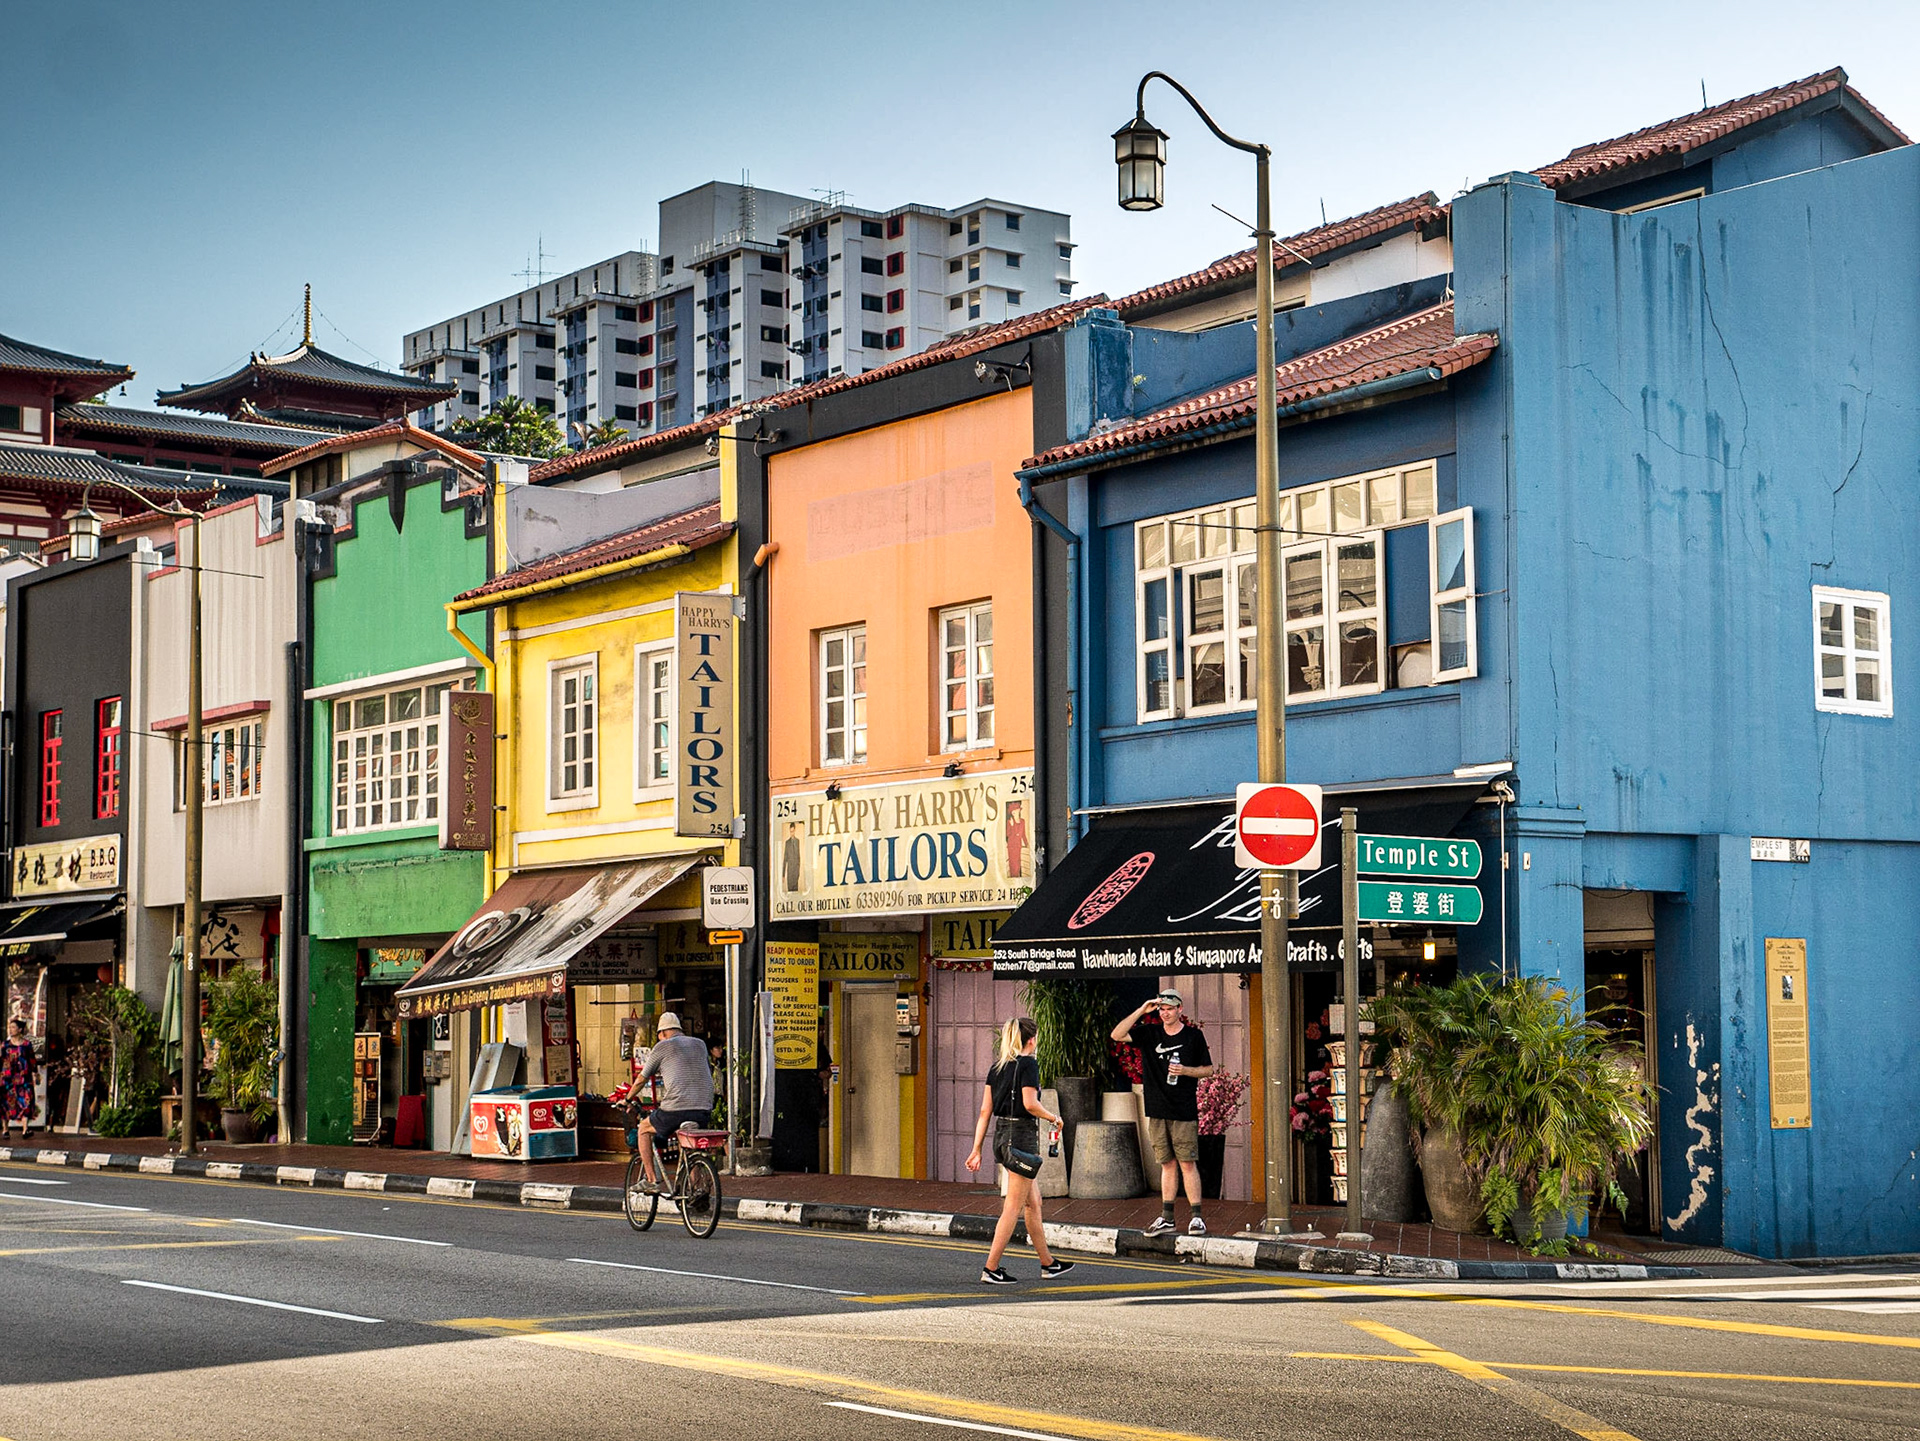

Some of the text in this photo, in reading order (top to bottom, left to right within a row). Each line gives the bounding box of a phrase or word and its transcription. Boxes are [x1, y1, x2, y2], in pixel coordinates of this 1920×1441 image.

[682, 606, 716, 618] HAPPY
[688, 617, 731, 629] HARRY'S
[687, 633, 724, 814] TAILORS
[1011, 774, 1035, 794] 254
[777, 800, 798, 818] 254
[808, 781, 998, 837] HAPPY HARRY'S
[710, 823, 730, 834] 254
[1751, 840, 1773, 849] EMPLE
[91, 846, 117, 868] B.B.Q
[818, 827, 988, 888] TAILORS
[1363, 840, 1469, 870] Temple St
[710, 884, 749, 893] PEDESTRIANS
[710, 896, 749, 906] Use Crossing
[776, 902, 795, 914] CALL
[798, 900, 813, 913] OUR
[816, 898, 851, 911] HOTLINE
[856, 890, 904, 909] 63389296
[907, 894, 923, 907] FOR
[927, 891, 956, 905] PICKUP
[960, 889, 993, 903] SERVICE
[997, 889, 1006, 901] 24
[1387, 891, 1454, 916] 登婆街
[767, 946, 785, 955] READY
[795, 948, 806, 956] ONE
[993, 948, 1076, 960] 252 South Bridge Road
[1081, 949, 1137, 969] Handmade
[1139, 947, 1171, 967] Asian
[1174, 947, 1185, 967] &
[1186, 944, 1246, 969] Singapore
[1248, 942, 1262, 963] Ar
[1287, 939, 1328, 962] Crafts
[769, 958, 815, 966] MADE TO ORDER
[819, 952, 905, 971] TAILORS
[567, 968, 600, 976] ADITIONAL
